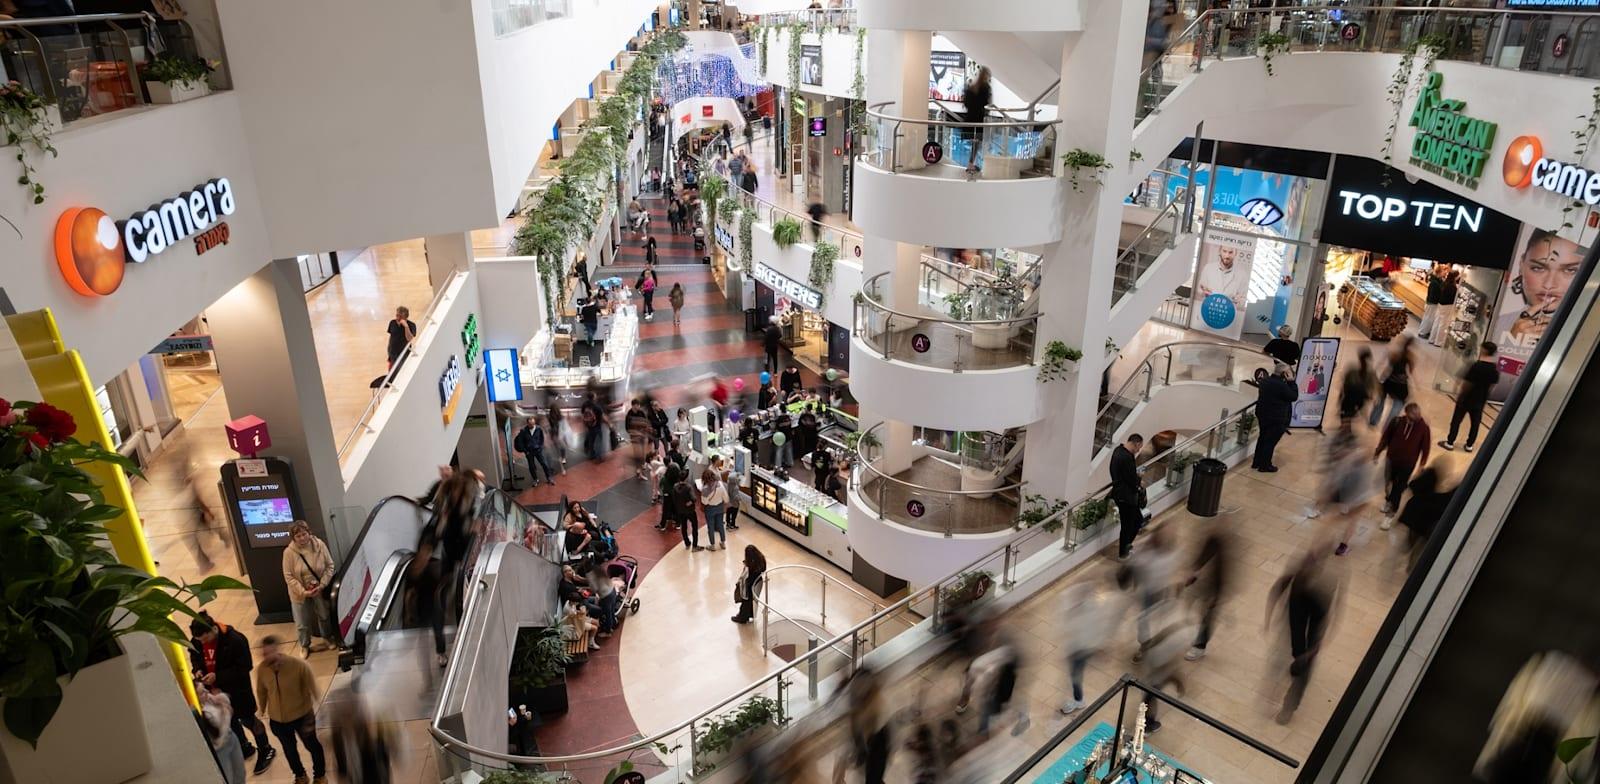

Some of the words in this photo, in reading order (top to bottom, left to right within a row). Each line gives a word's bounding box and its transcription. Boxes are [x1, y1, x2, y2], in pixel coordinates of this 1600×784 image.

[1409, 87, 1488, 147] AMERICAN
[1411, 133, 1484, 177] COMFORT
[123, 176, 236, 264] camera
[1339, 190, 1408, 223] TOP
[1408, 200, 1484, 233] TEN
[754, 262, 819, 309] SKECHERS
